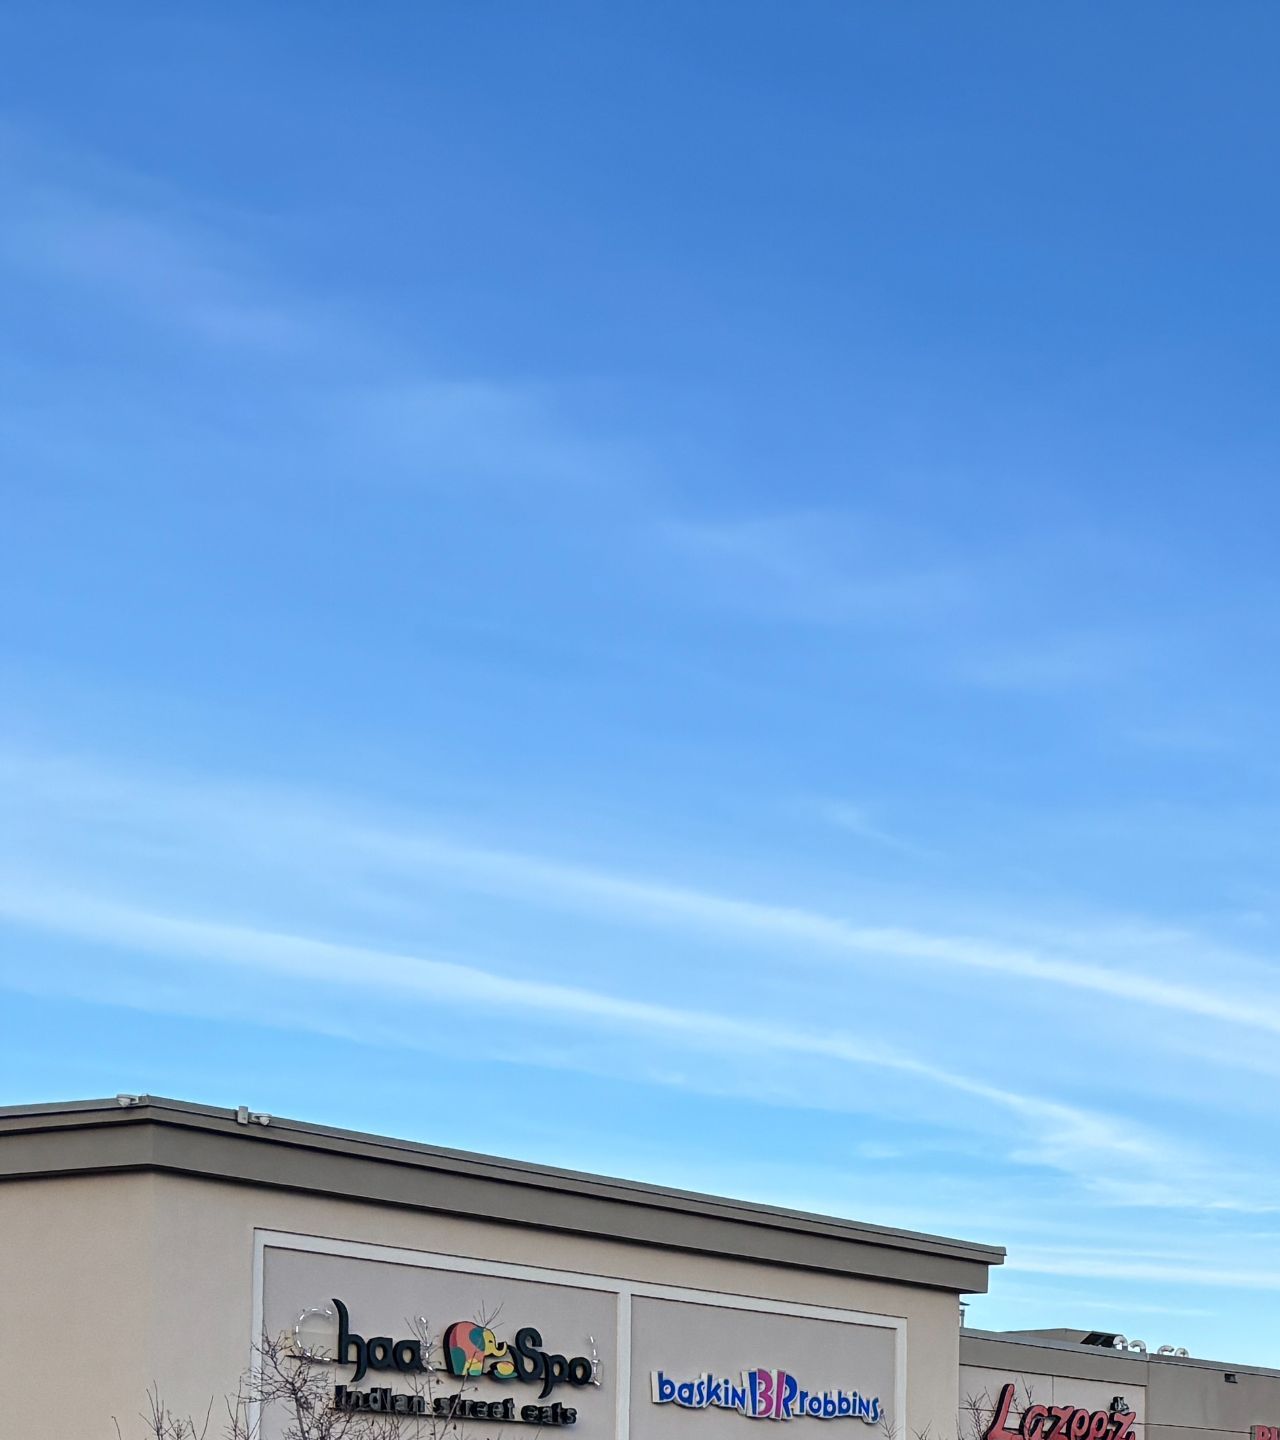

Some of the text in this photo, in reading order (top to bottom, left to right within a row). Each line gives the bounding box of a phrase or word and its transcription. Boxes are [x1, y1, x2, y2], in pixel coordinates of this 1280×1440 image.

[521, 1402, 579, 1425] eats
[651, 1367, 880, 1424] baskin BR robbins
